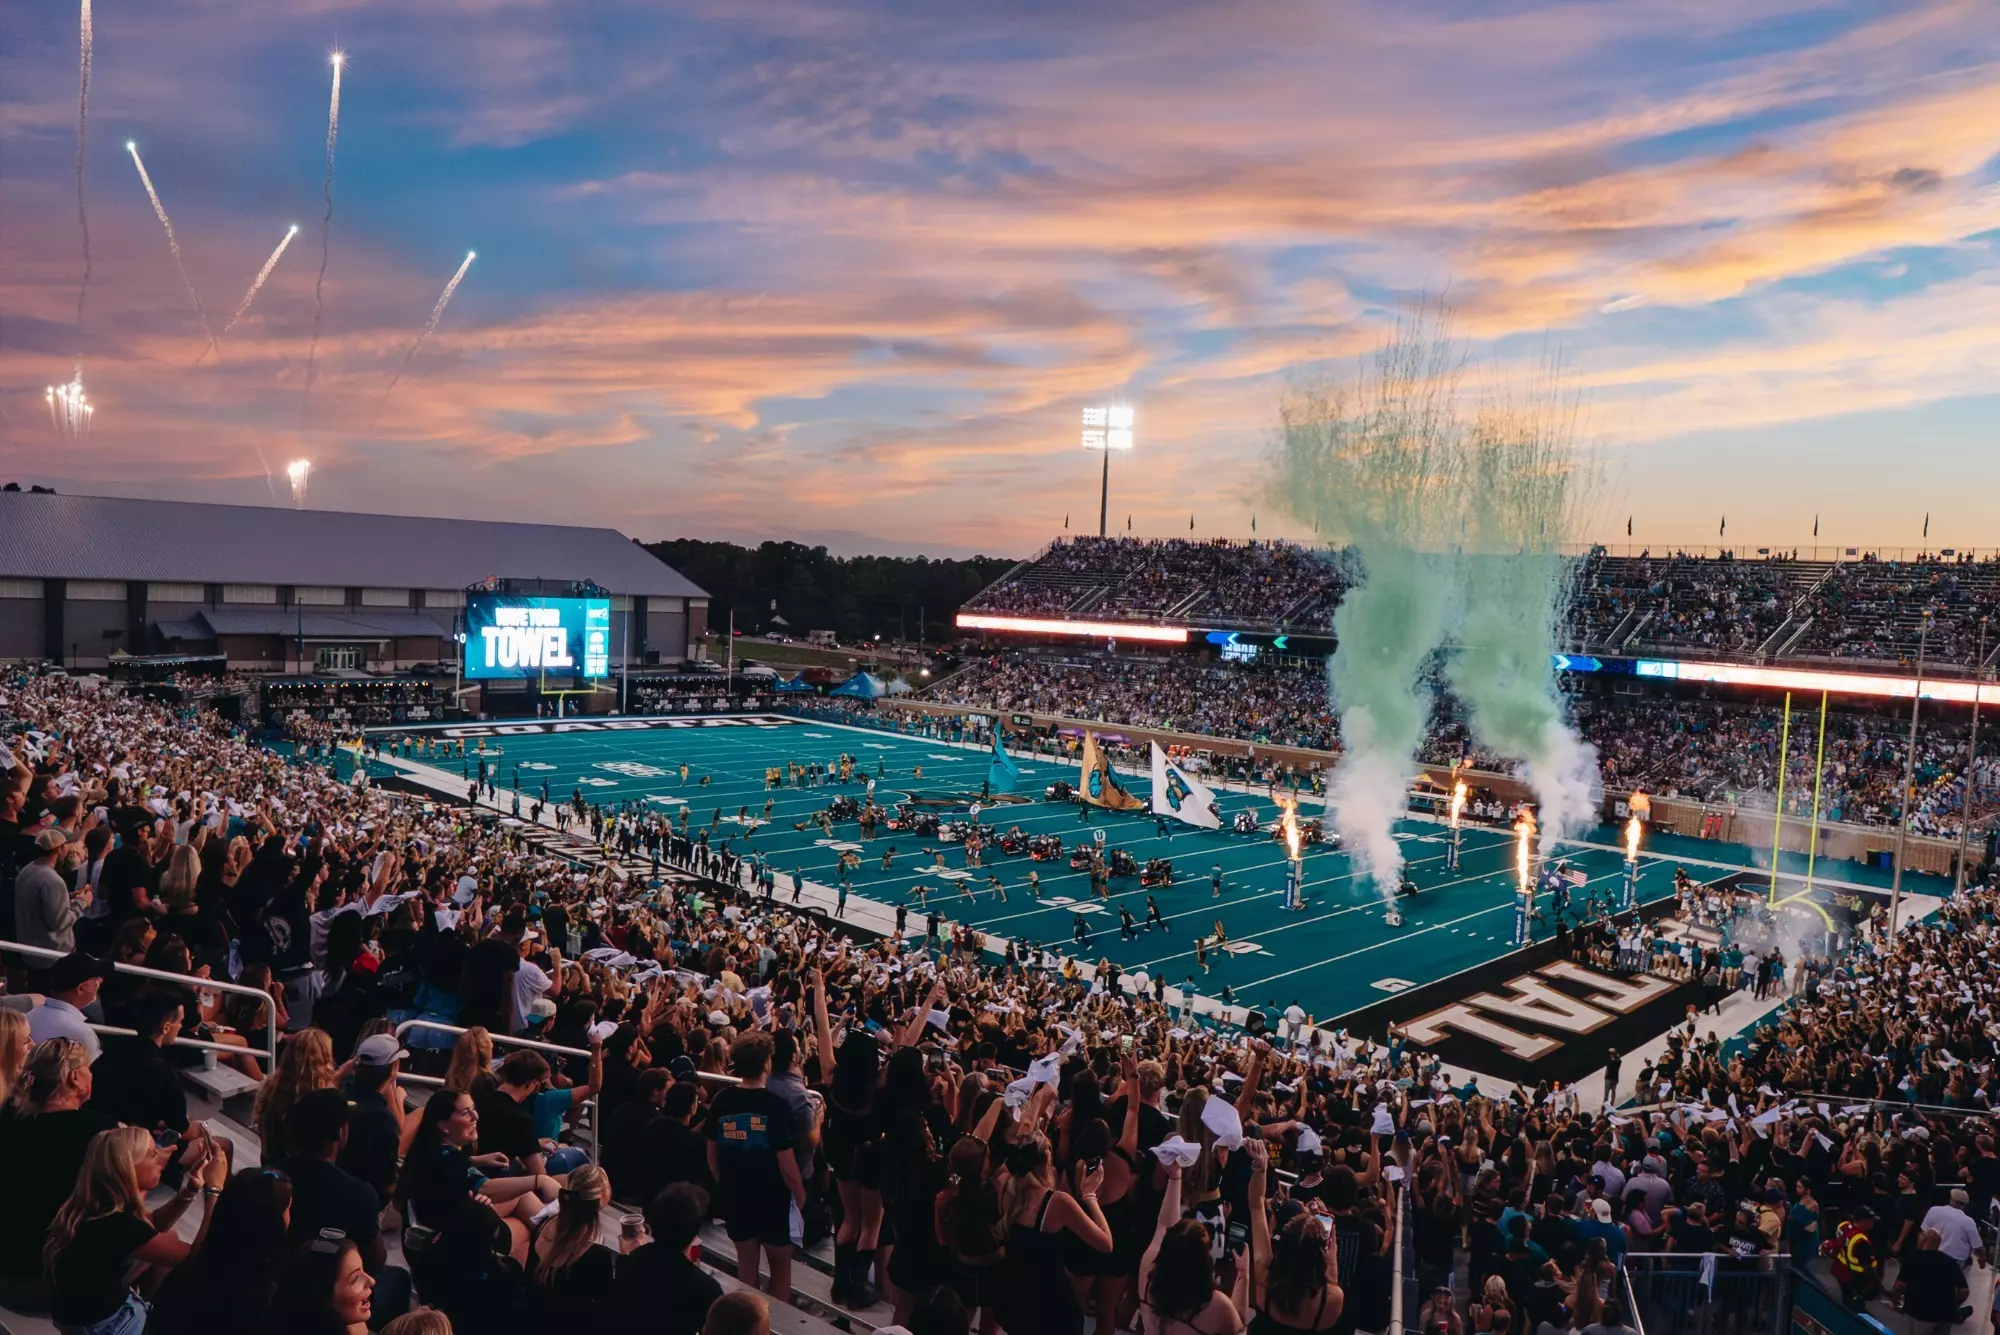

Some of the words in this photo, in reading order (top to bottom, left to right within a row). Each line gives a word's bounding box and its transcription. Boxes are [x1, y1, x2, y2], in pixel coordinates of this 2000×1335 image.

[481, 626, 573, 668] TOWEL
[442, 718, 795, 737] COASTAL
[1728, 1236, 1756, 1251] ROWDY
